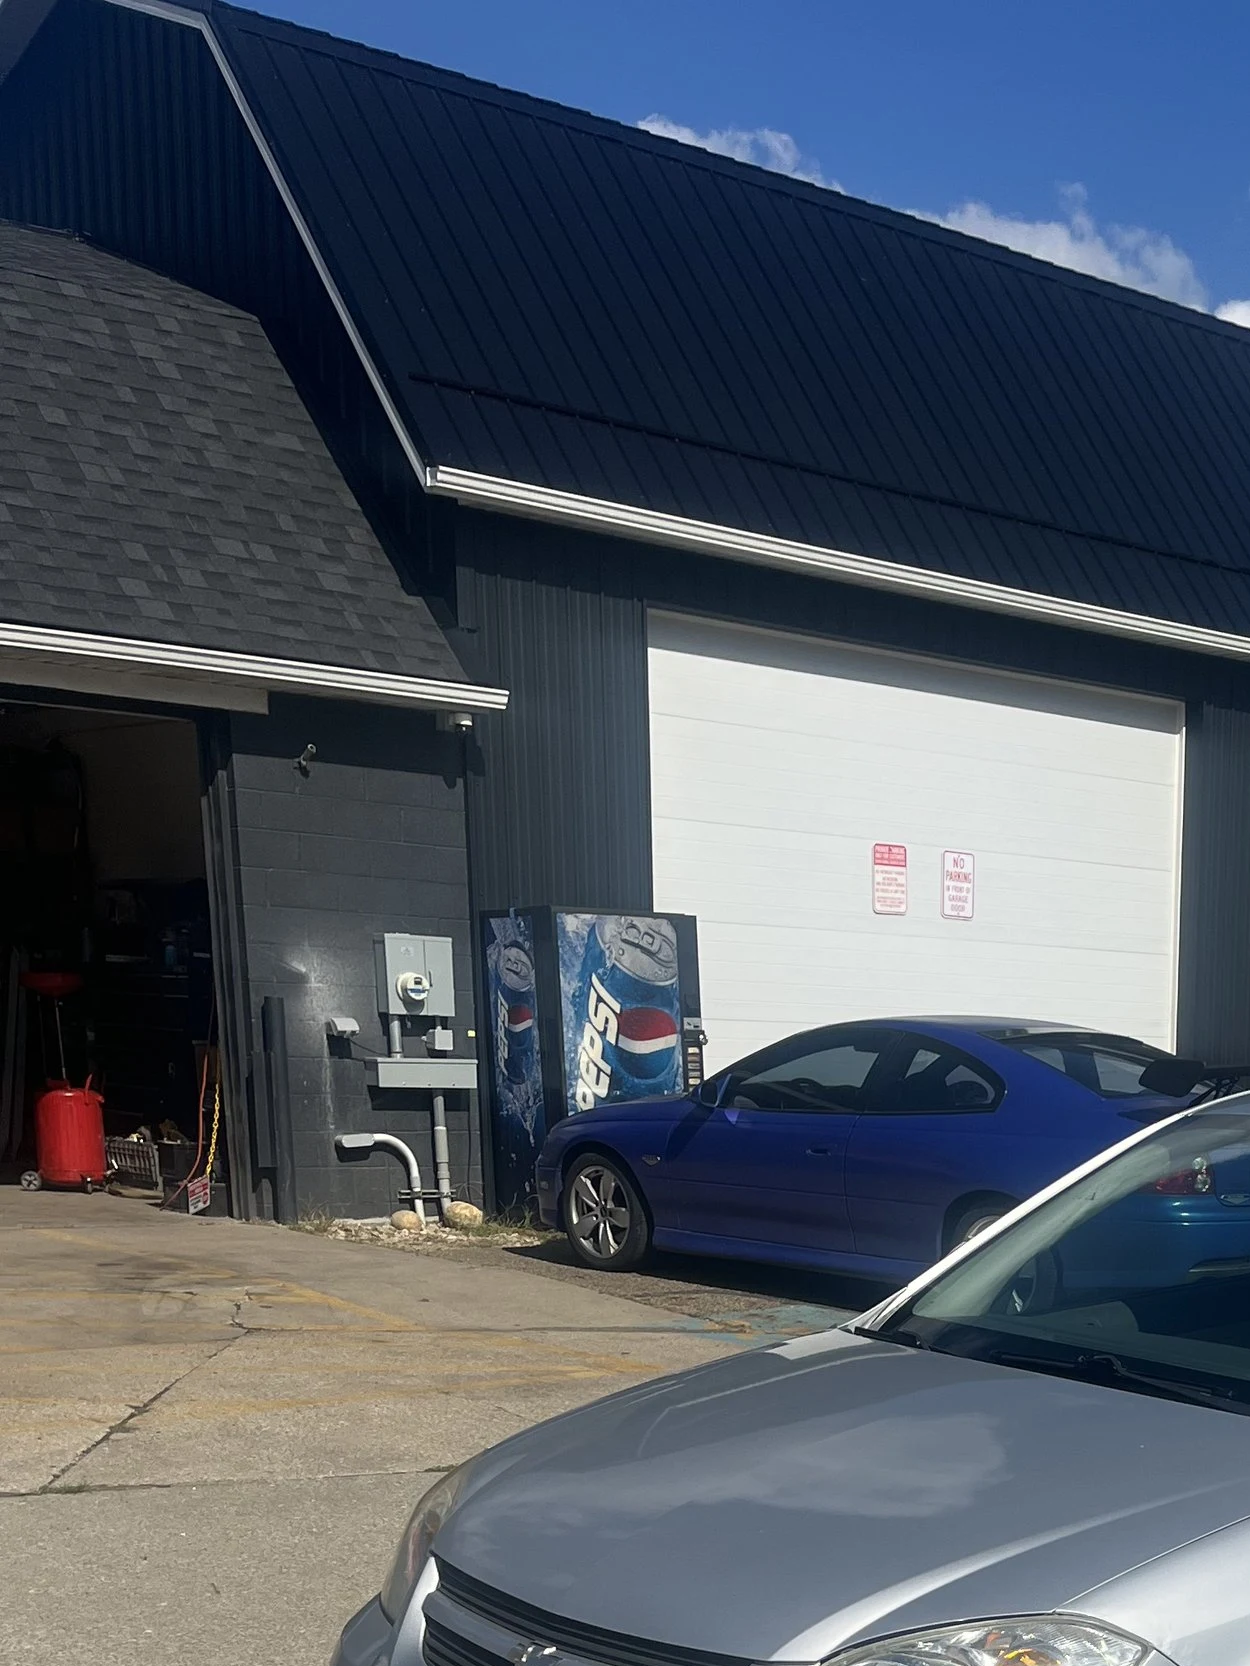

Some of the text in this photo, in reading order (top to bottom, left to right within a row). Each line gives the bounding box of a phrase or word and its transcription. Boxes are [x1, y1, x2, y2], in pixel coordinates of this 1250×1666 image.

[953, 857, 965, 869] NO
[946, 870, 972, 883] PARKING
[498, 989, 509, 1077] PEPSI
